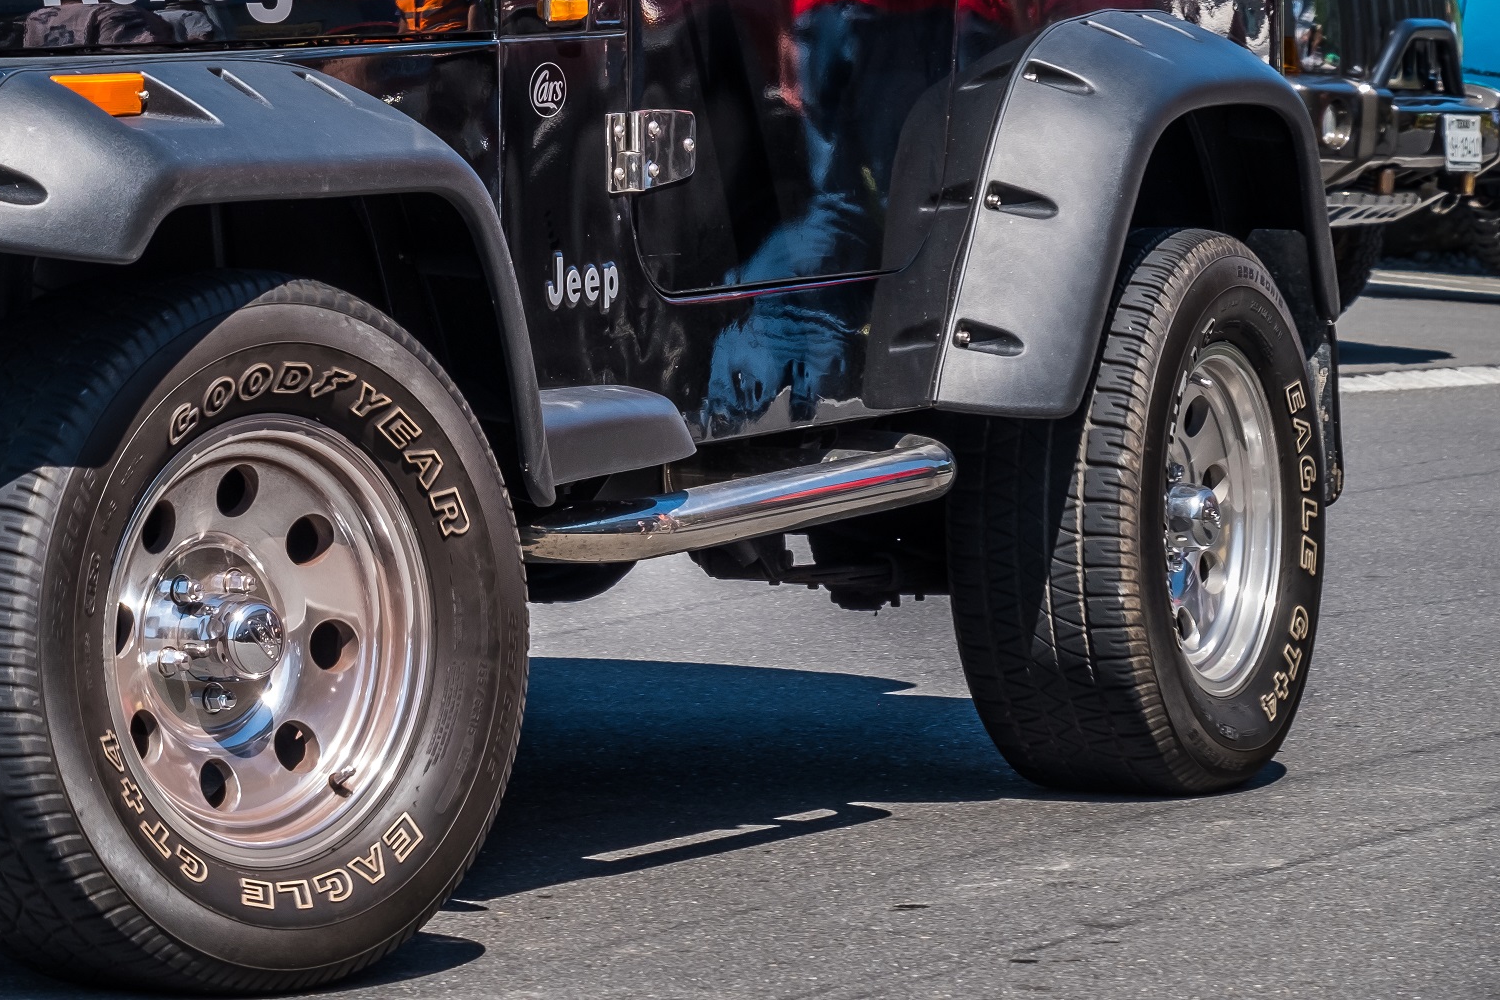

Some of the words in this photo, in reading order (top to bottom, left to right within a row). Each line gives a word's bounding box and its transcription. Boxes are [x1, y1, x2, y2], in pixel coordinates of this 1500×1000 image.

[533, 69, 564, 110] Cars
[546, 250, 620, 314] Jeep
[168, 360, 472, 541] GOODYEAR
[1283, 379, 1320, 577] EAGLE
[1259, 604, 1311, 723] GT+4
[100, 728, 209, 885] GT+4
[239, 810, 426, 912] EAGLE
